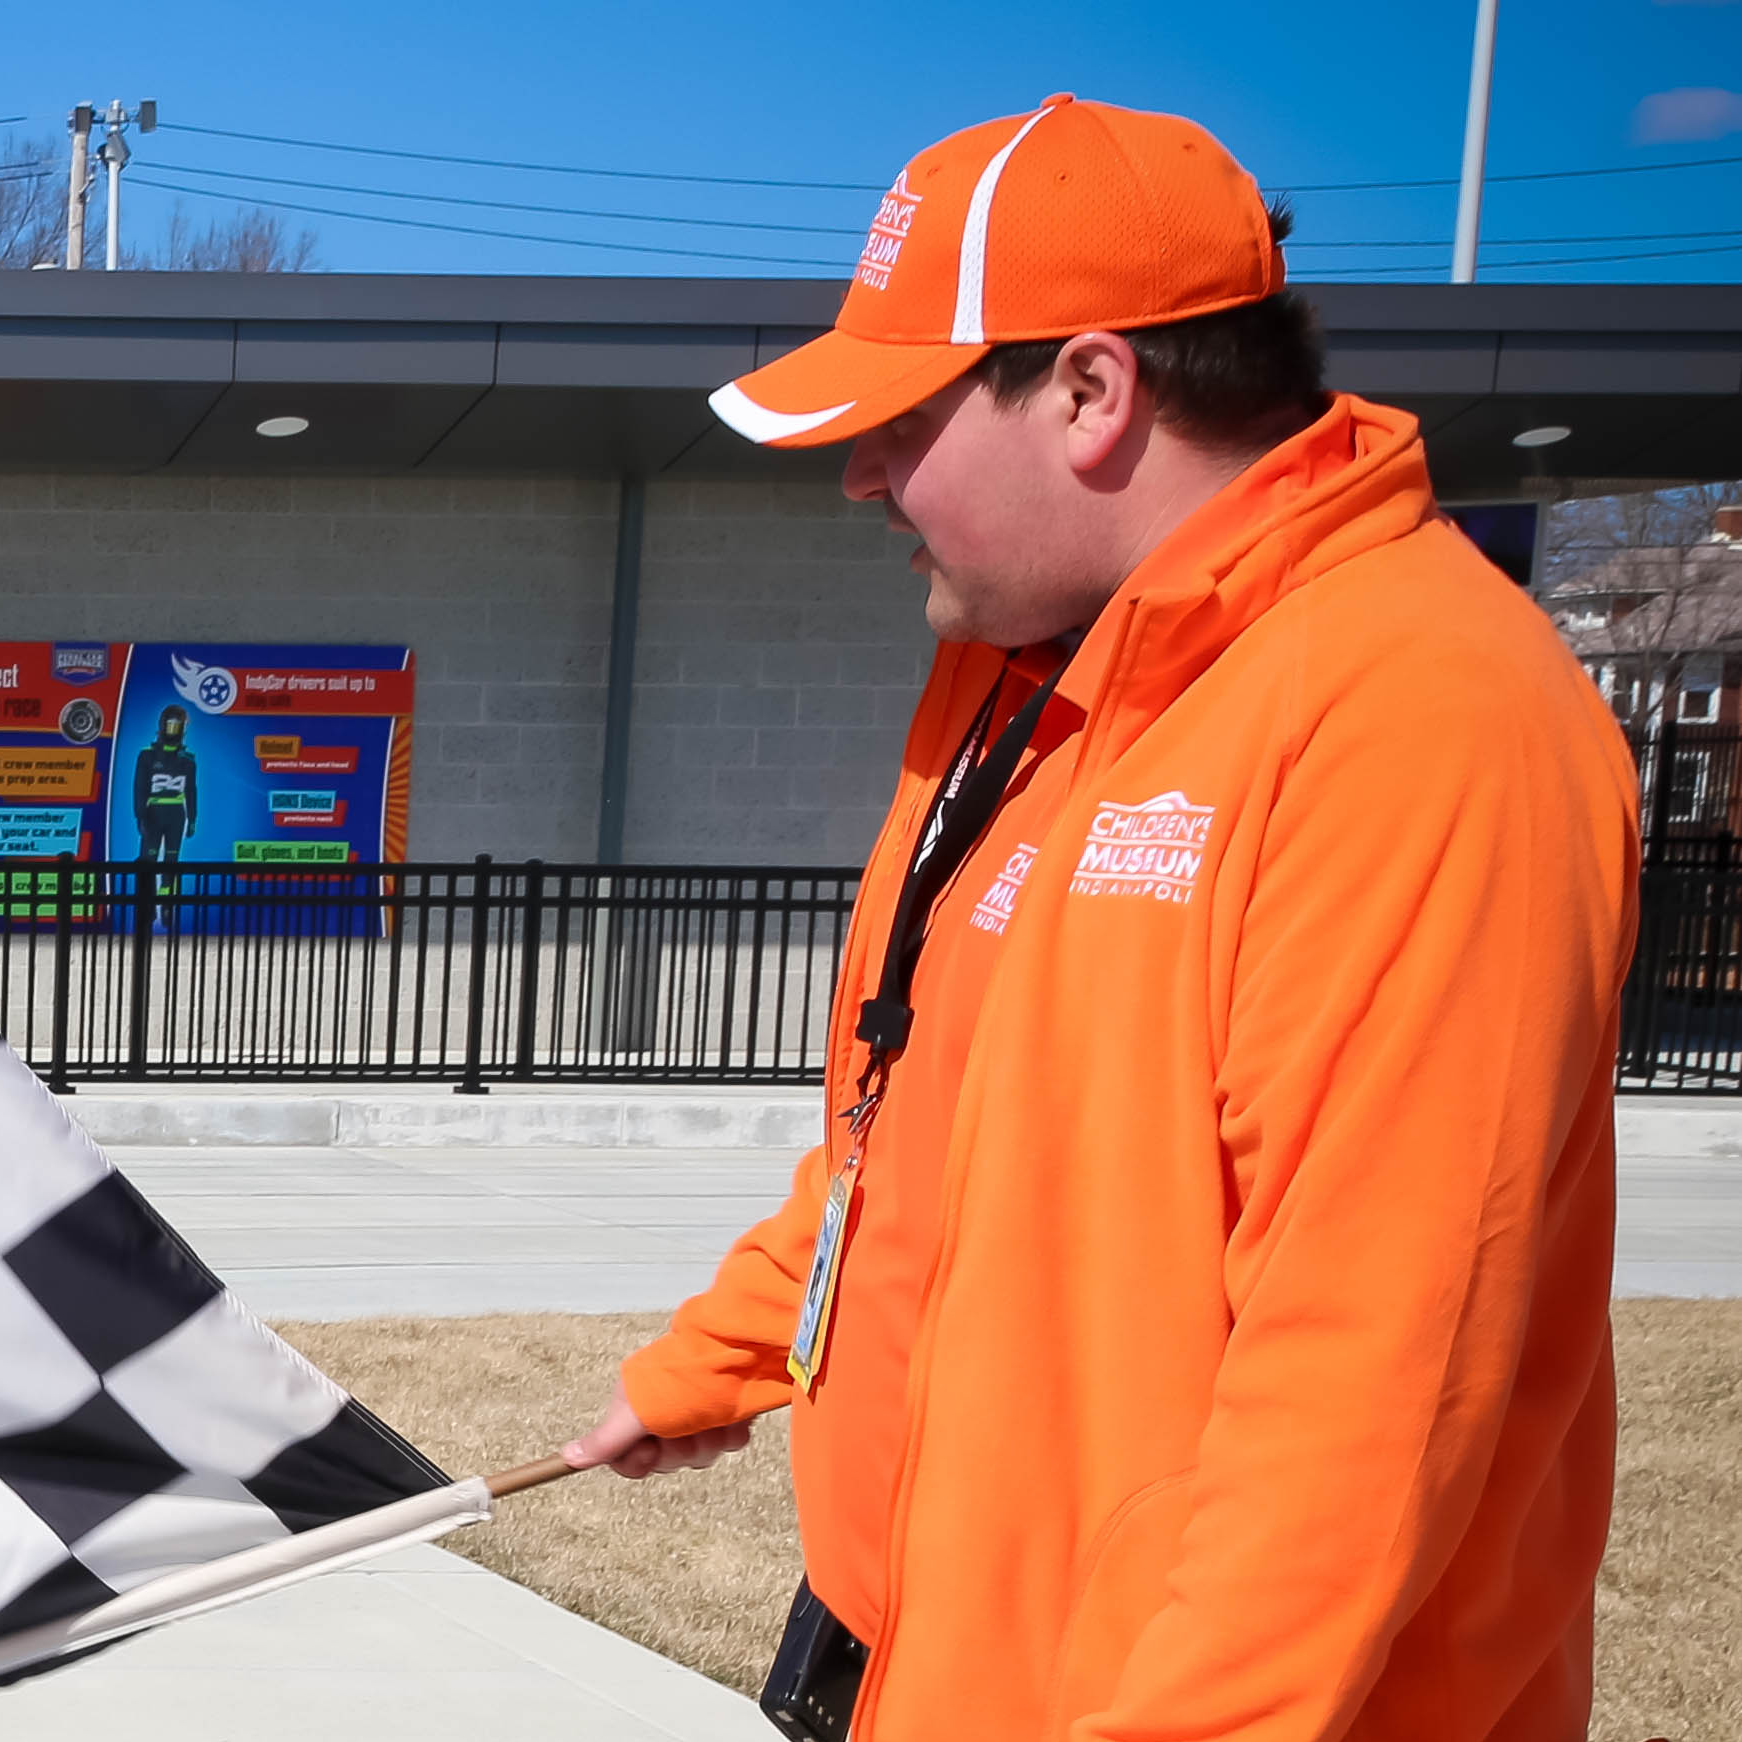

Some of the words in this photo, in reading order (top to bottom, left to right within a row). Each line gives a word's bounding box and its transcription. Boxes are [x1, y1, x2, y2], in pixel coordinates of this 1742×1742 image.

[287, 674, 326, 691] drivers
[349, 678, 364, 693] up
[365, 675, 375, 691] to
[3, 698, 41, 717] race
[3, 761, 33, 769] crew
[35, 759, 85, 770] member
[7, 775, 34, 787] prep
[37, 775, 68, 785] area.
[151, 773, 187, 793] 24
[15, 812, 65, 823] member
[2, 828, 29, 841] your
[32, 829, 52, 838] car
[53, 827, 76, 838] and
[8, 841, 40, 851] seat.
